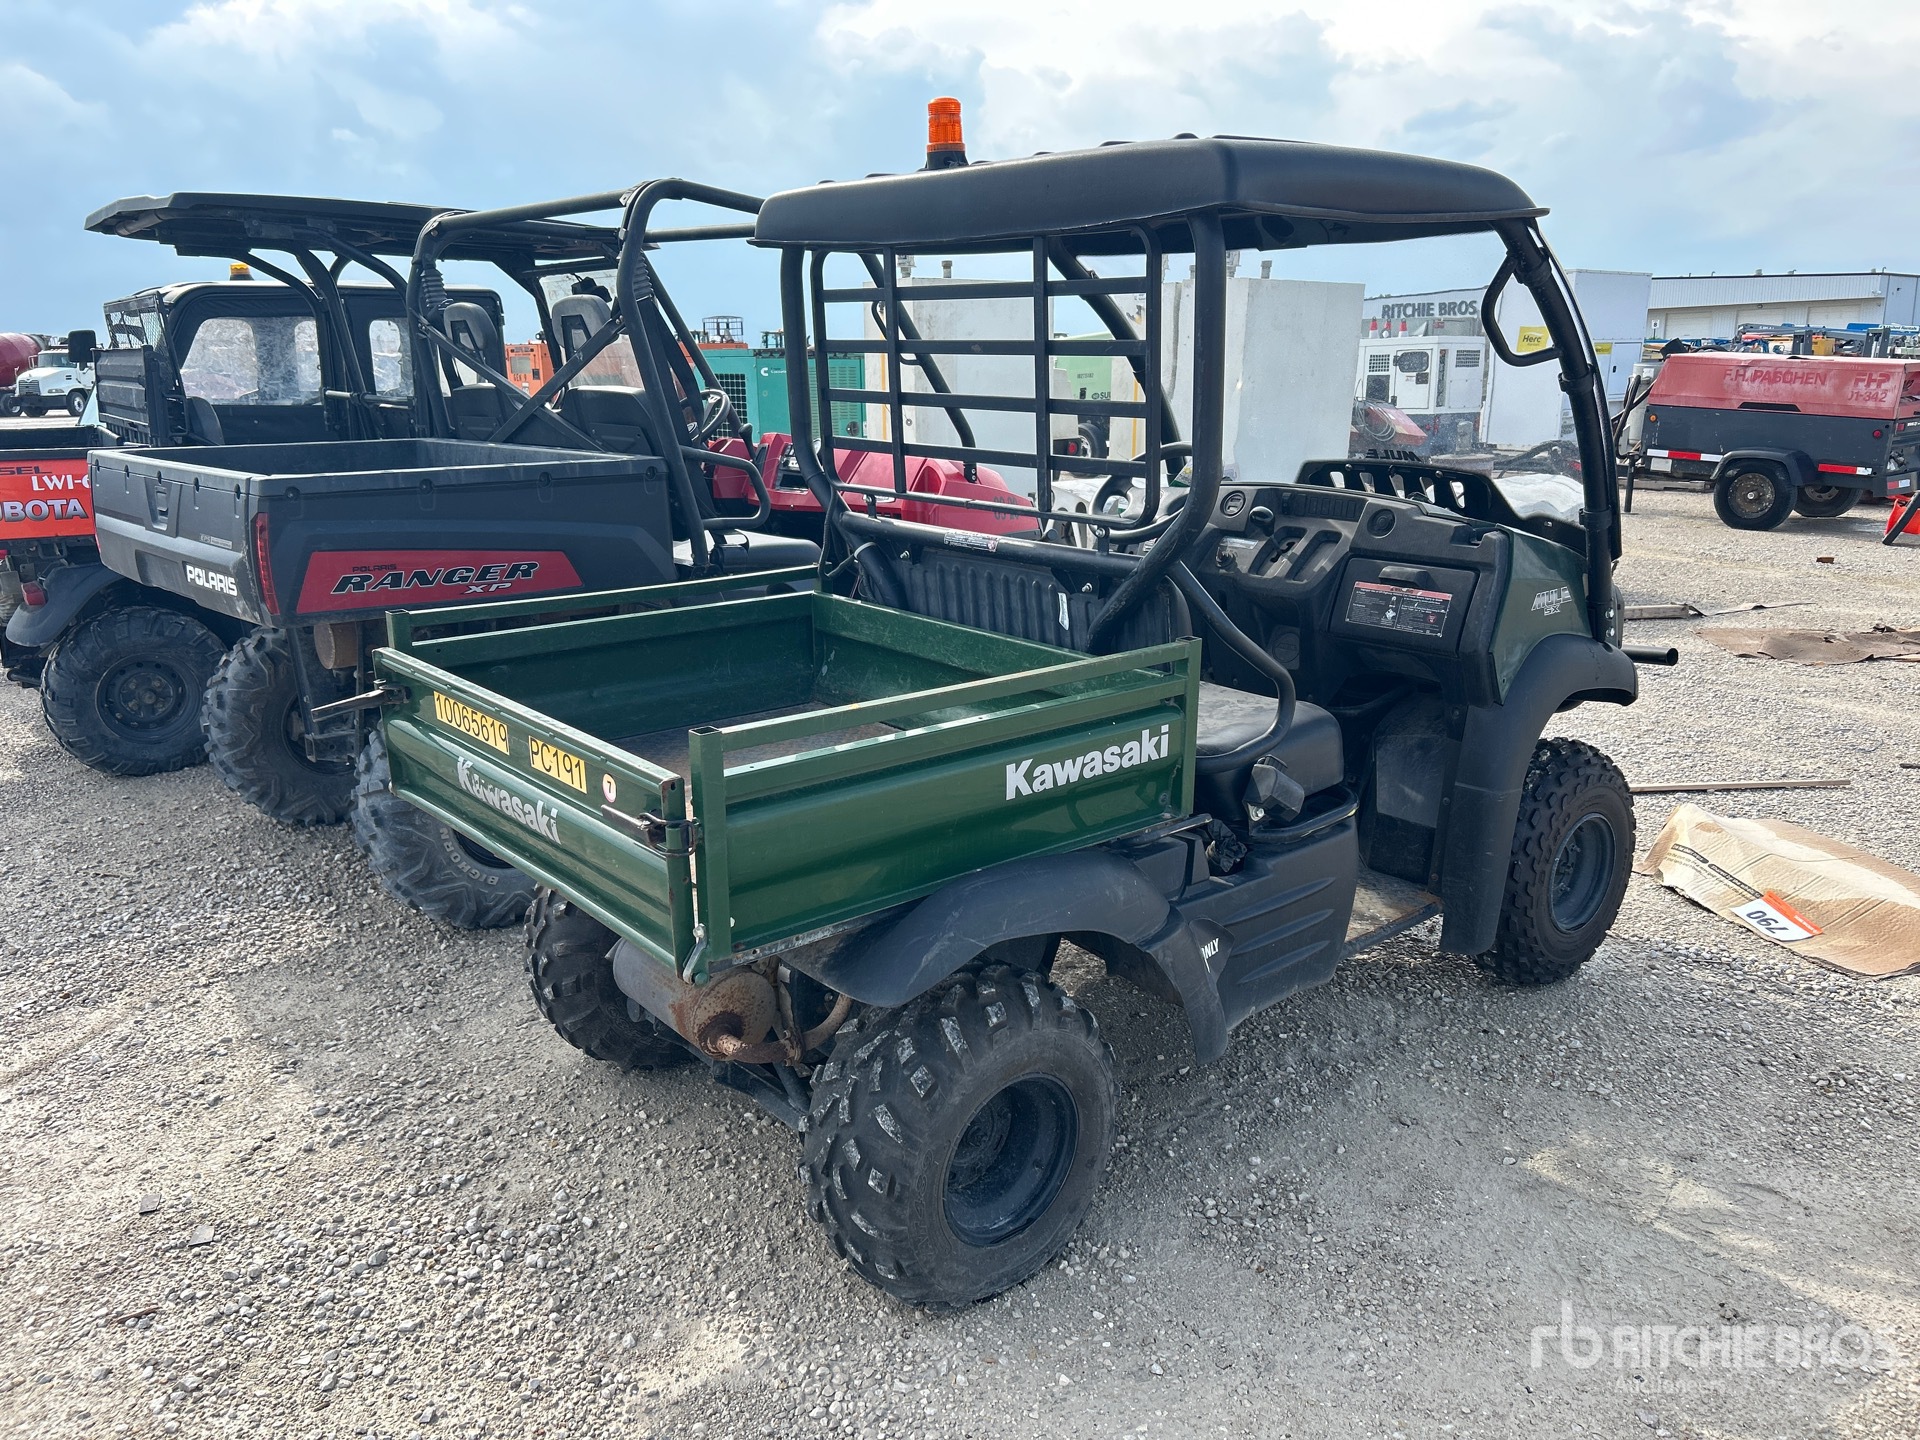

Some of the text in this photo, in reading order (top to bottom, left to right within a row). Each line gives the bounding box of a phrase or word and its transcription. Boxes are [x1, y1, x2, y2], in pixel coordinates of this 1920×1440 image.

[1381, 300, 1477, 319] RITCHIE BROS
[1522, 334, 1541, 343] Herc
[0, 498, 88, 523] BOTA
[186, 564, 238, 597] POLARIS
[330, 561, 540, 595] RANGER
[352, 563, 397, 573] POLARIS
[462, 582, 512, 595] XP
[1531, 586, 1572, 611] MULE
[435, 693, 509, 751] 10065619
[530, 736, 585, 790] PC191
[1005, 724, 1170, 800] Kawasaki
[457, 756, 562, 845] Kawasaki
[439, 827, 499, 886] BIGHORN
[1746, 910, 1790, 935] 790
